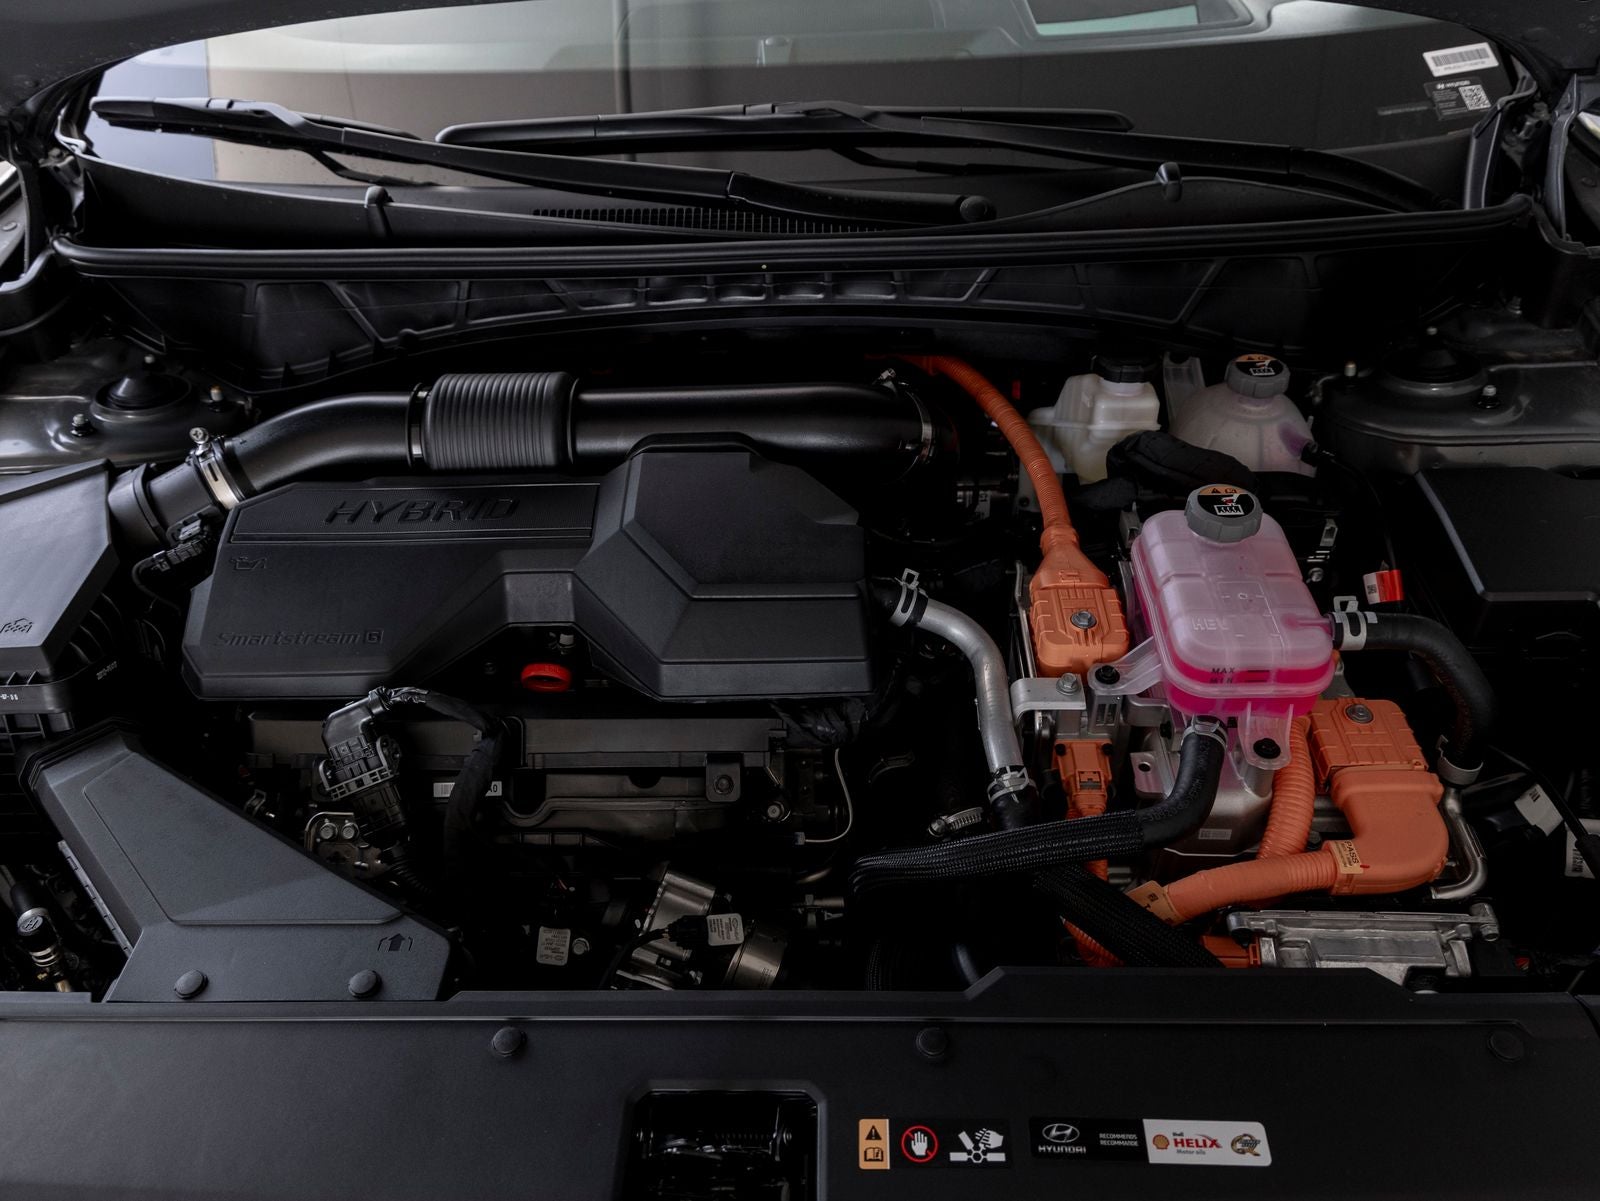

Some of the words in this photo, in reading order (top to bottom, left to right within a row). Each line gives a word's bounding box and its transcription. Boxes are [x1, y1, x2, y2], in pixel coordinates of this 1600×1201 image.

[323, 497, 520, 524] HYBRID
[217, 631, 361, 647] Smartstream
[1344, 841, 1360, 864] PASS
[1038, 1144, 1087, 1154] HYUNDAI
[1173, 1137, 1221, 1149] HELIX
